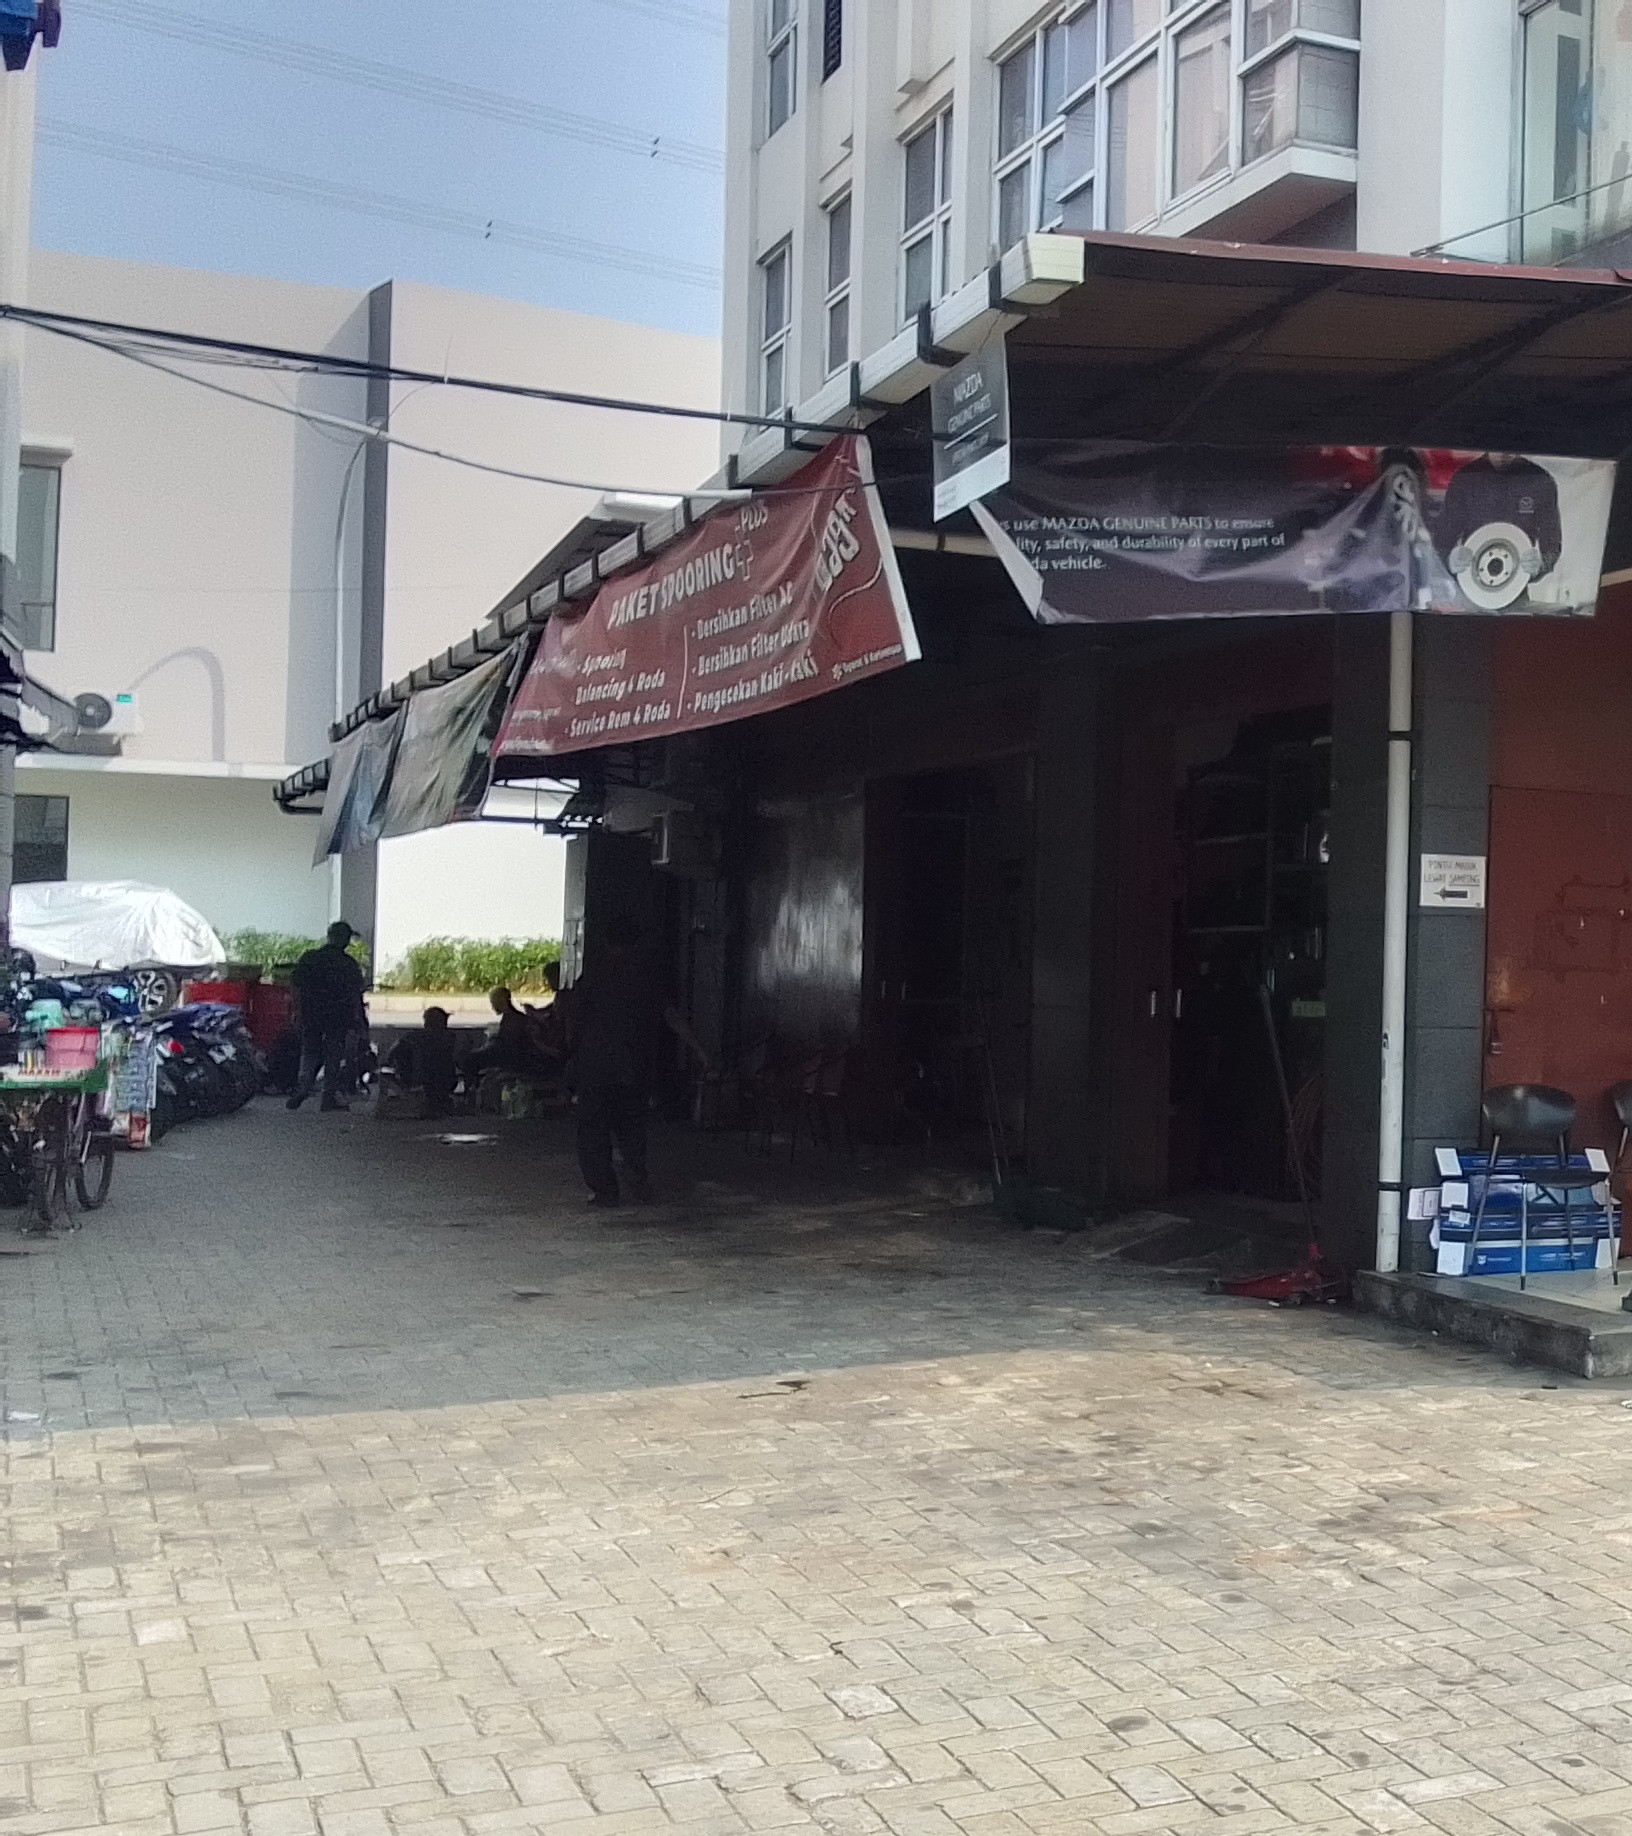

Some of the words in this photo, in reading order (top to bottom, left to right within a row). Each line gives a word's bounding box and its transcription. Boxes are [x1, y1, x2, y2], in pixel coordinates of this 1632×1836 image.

[741, 506, 769, 533] PLUS
[1042, 516, 1100, 531] MAZDA
[1103, 517, 1167, 531] GENUINE
[1171, 516, 1213, 530] PARTS
[1215, 518, 1229, 529] to
[1015, 536, 1042, 554] lity,
[1045, 536, 1090, 554] safety,
[1093, 536, 1119, 549] and
[1122, 535, 1185, 551] durability
[1187, 536, 1201, 548] of
[1204, 537, 1239, 550] every
[1242, 535, 1269, 550] part
[1271, 533, 1286, 546] of
[607, 582, 661, 631] PAKET
[660, 543, 736, 611] SPOORING
[697, 606, 749, 640] Bersihkan
[750, 593, 778, 622] Filter
[697, 642, 750, 677] Bersihkan
[751, 632, 780, 660] Filter
[575, 677, 627, 705] Balancing
[636, 668, 667, 692] Roda
[693, 677, 759, 713] Pengecekan
[761, 663, 784, 694] Kaki
[569, 711, 607, 738] Service
[607, 710, 632, 730] Rem
[642, 699, 672, 724] Roda
